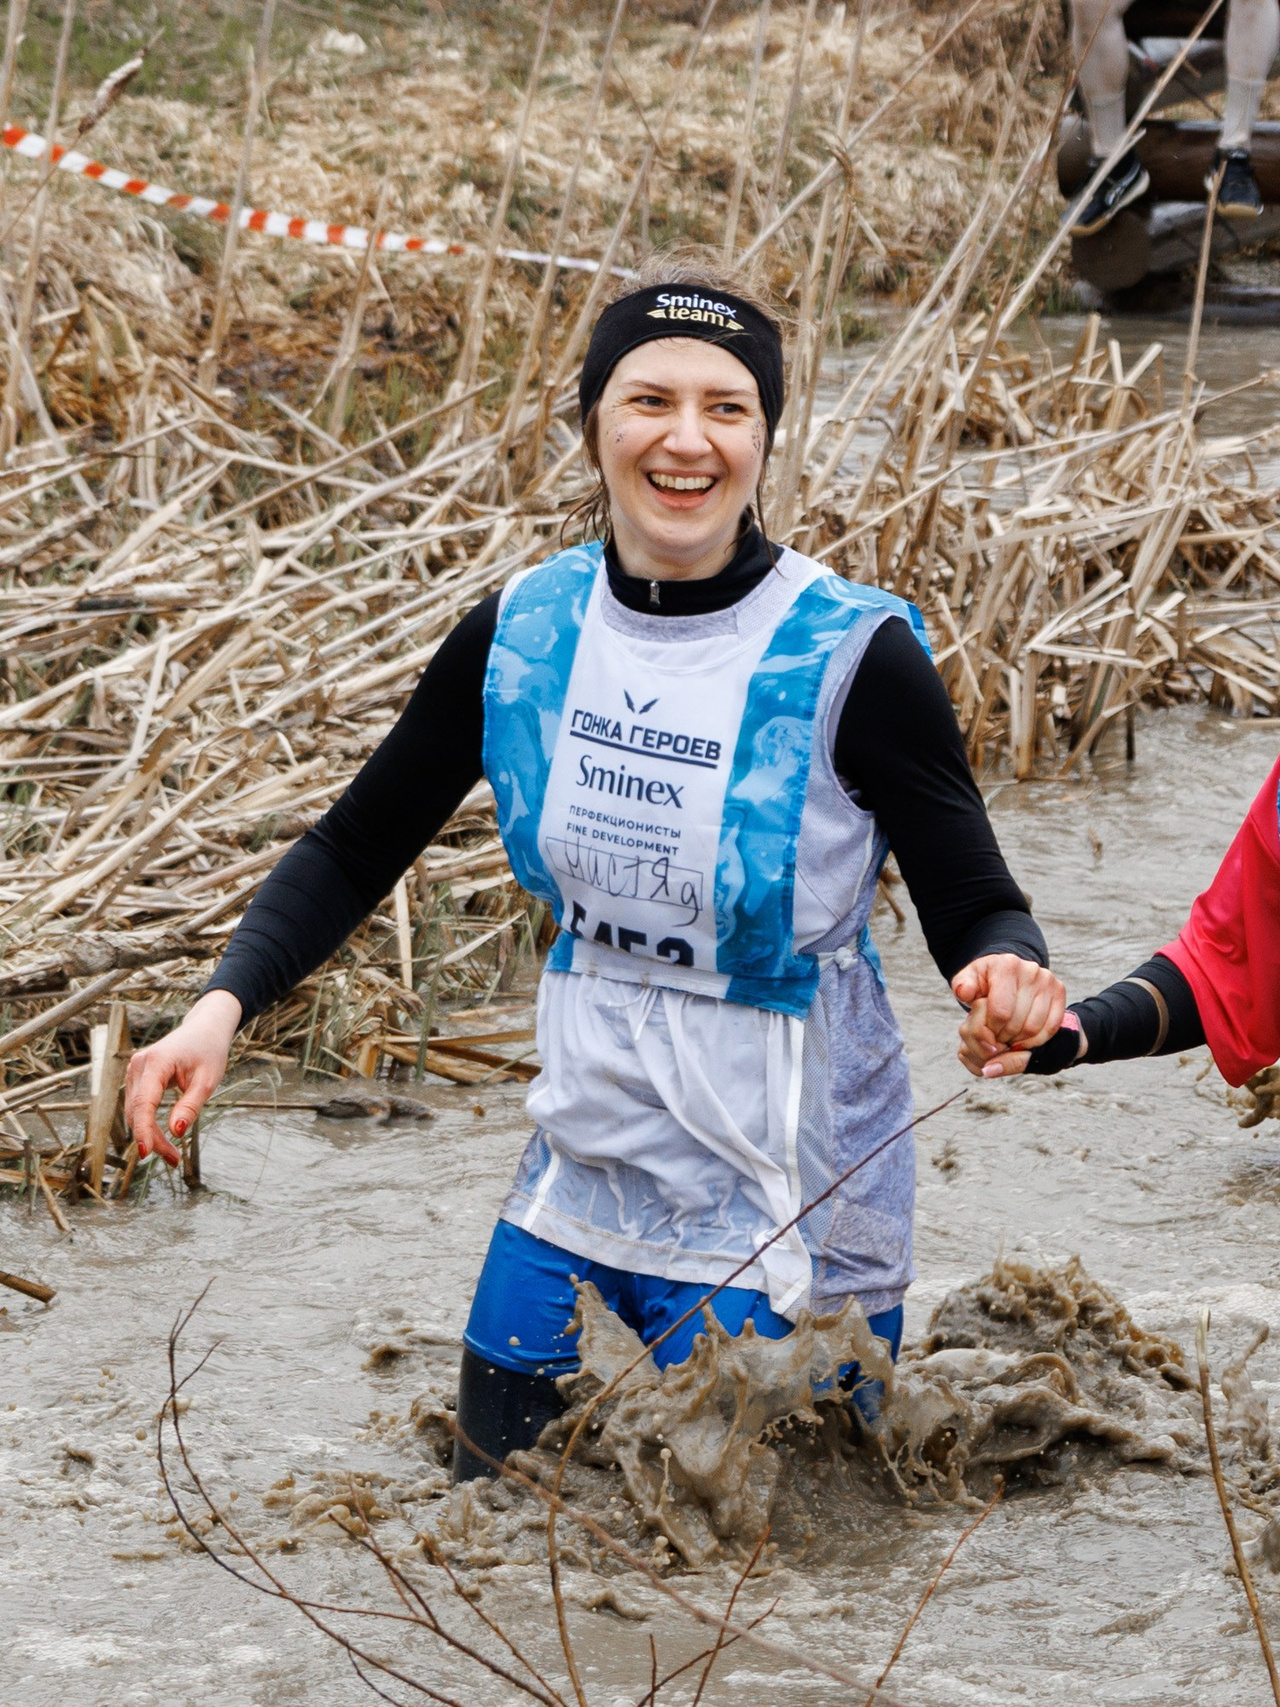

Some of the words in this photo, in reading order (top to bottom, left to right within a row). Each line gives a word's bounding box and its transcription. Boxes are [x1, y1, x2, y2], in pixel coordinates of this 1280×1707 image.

[655, 293, 737, 319] Sminex
[668, 305, 725, 326] team
[571, 709, 623, 742] ГОНКА
[629, 725, 722, 761] ГЕРОЕВ
[576, 754, 685, 809] Sminex
[567, 822, 588, 836] FINE
[592, 829, 679, 855] DEVELOPMENT
[569, 805, 681, 839] ПЕРФЕКЦИОНИСТЫ
